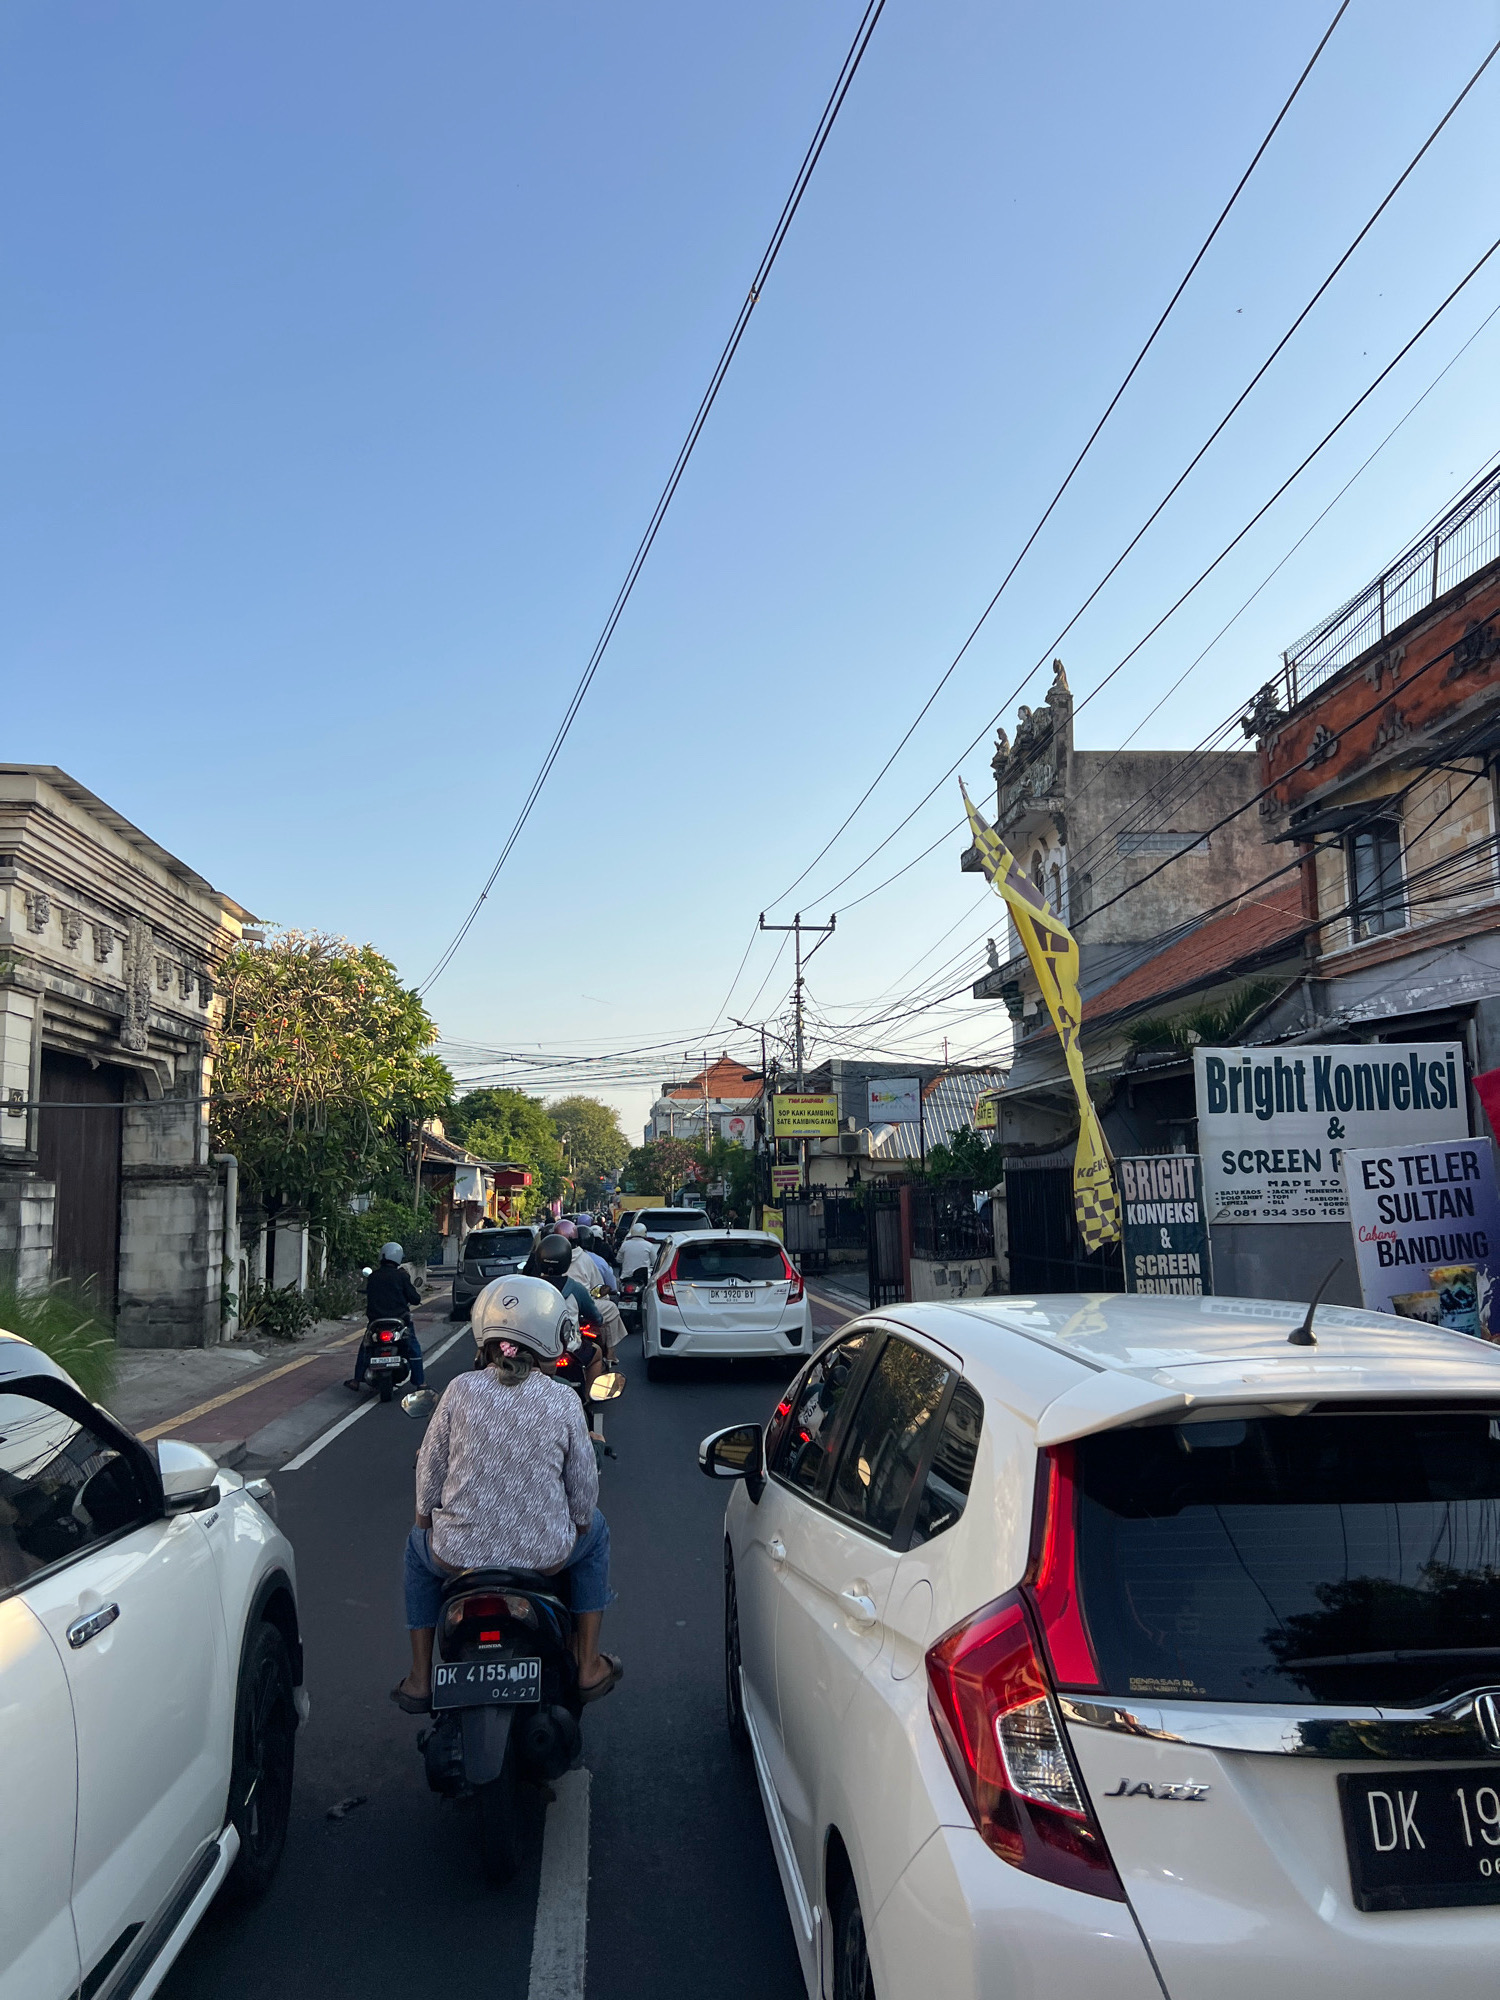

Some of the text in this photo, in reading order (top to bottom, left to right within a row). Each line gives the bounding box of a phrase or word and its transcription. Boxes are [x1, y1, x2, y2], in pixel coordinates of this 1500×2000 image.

[1205, 1051, 1458, 1121] Bright Konveksi
[1327, 1116, 1346, 1140] &
[1221, 1149, 1322, 1175] SCREEN
[1361, 1158, 1396, 1190] ES
[1398, 1150, 1481, 1186] TELER
[1121, 1158, 1196, 1201] BRIGHT
[1320, 1179, 1341, 1187] TO
[1126, 1202, 1200, 1225] KONVEKSI
[1233, 1207, 1346, 1217] 081 934 350 165
[1377, 1187, 1475, 1225] SULTAN
[1160, 1227, 1173, 1249] &
[1358, 1225, 1398, 1244] Cabang
[1376, 1231, 1490, 1268] BANDUNG
[1135, 1253, 1201, 1276] SCREEN
[710, 1289, 720, 1299] DK
[744, 1288, 754, 1299] BY
[437, 1667, 458, 1686] DK
[466, 1664, 507, 1682] 4155
[1103, 1777, 1211, 1802] JAZZ
[1367, 1790, 1426, 1851] DK
